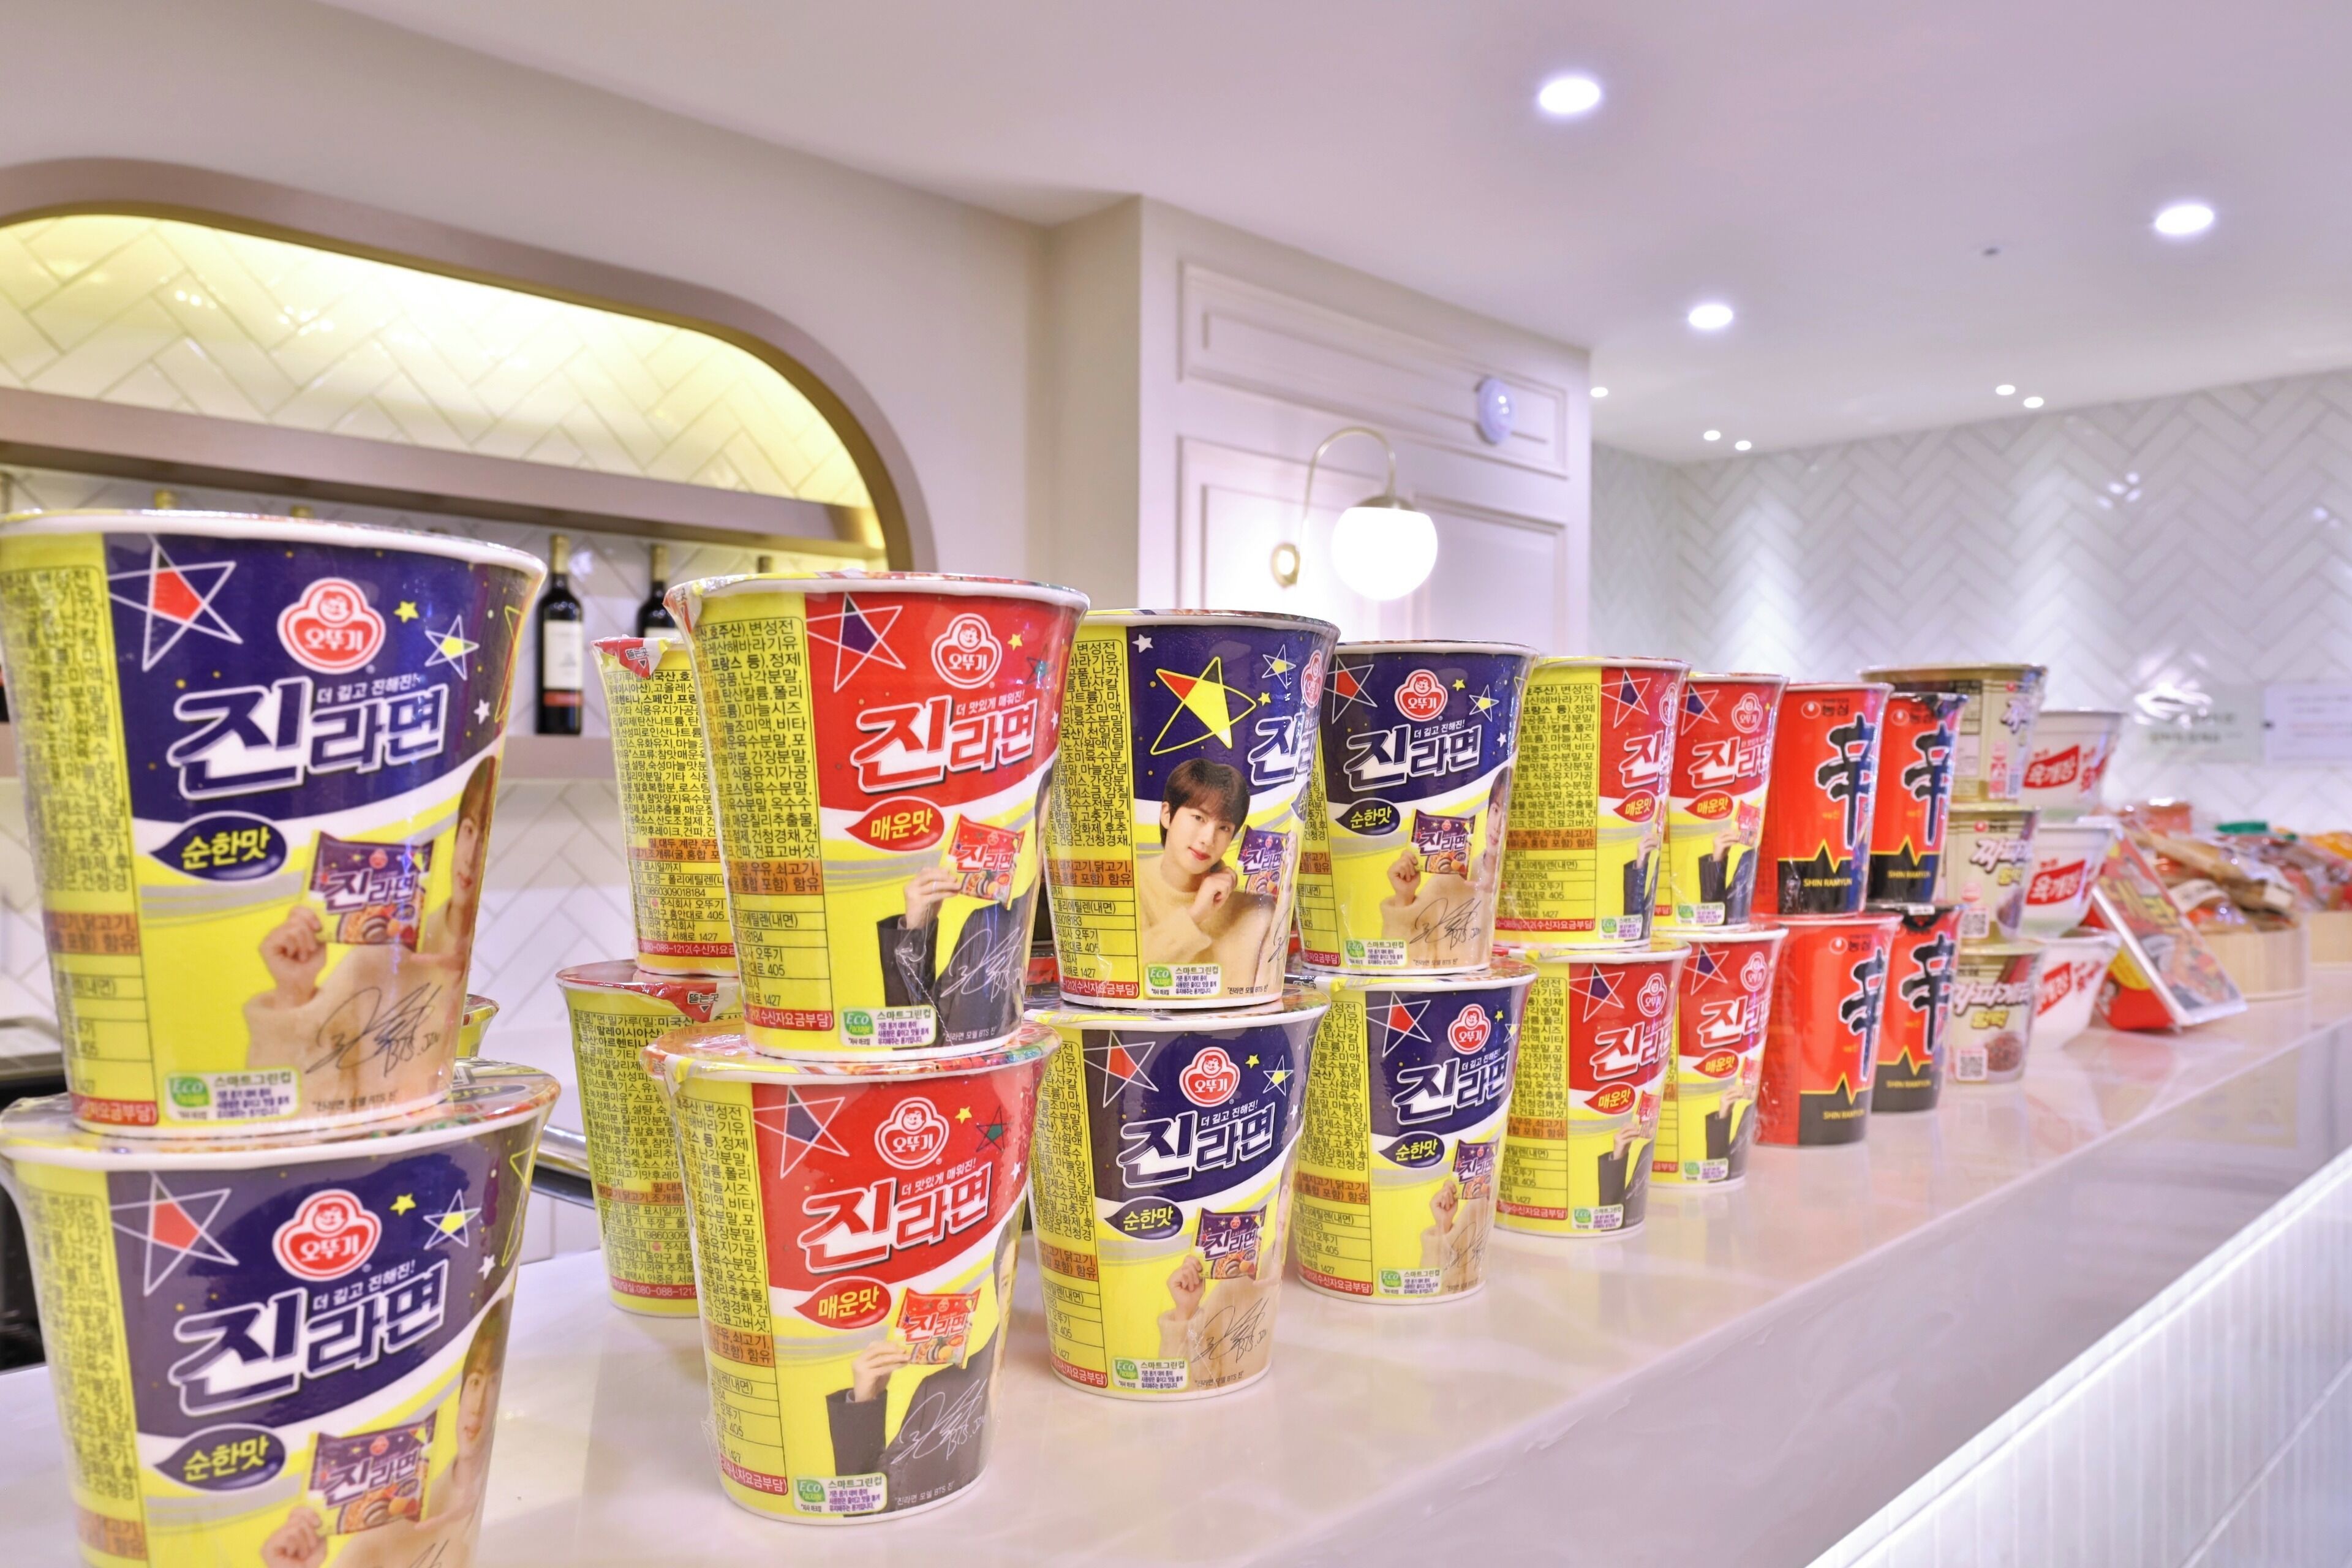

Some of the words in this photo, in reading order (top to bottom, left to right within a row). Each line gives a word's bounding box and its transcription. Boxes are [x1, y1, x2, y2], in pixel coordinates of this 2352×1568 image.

[305, 630, 363, 652] 오뚜기
[626, 648, 649, 660] 뜯는곳
[1077, 642, 1115, 656] 변성전
[948, 654, 987, 671] 오뚜기
[318, 687, 333, 703] 더
[371, 674, 420, 696] 진해진!
[956, 705, 965, 715] 더
[969, 699, 996, 714] 맛있게
[998, 692, 1025, 707] 매워진!
[1063, 703, 1125, 715] 마늘조미액,
[1408, 697, 1438, 710] 오뚜기
[1414, 729, 1422, 739] 더
[1424, 727, 1439, 736] 깊고
[1441, 719, 1466, 734] 진해진!
[167, 677, 449, 800] 진라면
[850, 695, 1038, 793] 진라면
[1343, 724, 1482, 792] 진라면
[733, 766, 808, 780] 식용유지가공
[1814, 712, 1879, 850] 辛
[1902, 721, 1955, 846] 辛
[1624, 797, 1653, 816] 매운맛
[1696, 796, 1729, 817] 매운맛
[871, 805, 933, 841] 매운맛
[1350, 807, 1392, 829] 순한맛
[181, 829, 271, 870] 순한맛
[1419, 831, 1466, 857] 진라면
[1577, 839, 1595, 848] 함유
[956, 844, 1014, 873] 진라면
[1243, 847, 1283, 876] 진라면
[644, 862, 682, 873] 표시일까지
[763, 878, 788, 892] 포함)
[794, 877, 820, 891] 함유
[1081, 873, 1104, 886] 포함)
[1108, 873, 1132, 886] 함유
[1539, 881, 1563, 891] 오뚜기
[1803, 878, 1823, 887] SHIN
[1824, 878, 1853, 887] RAMYUN
[325, 868, 418, 914] 진라면
[645, 887, 706, 897] 19860309018184
[660, 899, 692, 908] 주식회사
[696, 899, 724, 909] 오뚜기
[1057, 900, 1116, 914] 폴리에틸렌(내면)
[664, 921, 695, 931] 주식회사
[672, 931, 696, 941] 서해로
[699, 933, 718, 941] 1427
[756, 948, 783, 962] 오뚜기
[767, 964, 785, 976] 405
[1080, 968, 1096, 978] 1427
[1150, 968, 1169, 978] Eco
[1175, 966, 1219, 975] 스마트그린컵
[689, 992, 719, 1003] 뜯는곳
[764, 993, 781, 1006] 1427
[1901, 932, 1958, 1054] 辛
[846, 1014, 869, 1025] Eco
[876, 1008, 931, 1020] 스마트그린컵
[1840, 948, 1887, 1082] 辛
[1458, 1030, 1482, 1043] 오뚜기
[1462, 1062, 1468, 1071] 더
[1705, 1055, 1735, 1074] 매운맛
[1194, 1078, 1228, 1093] 오뚜기
[1392, 1051, 1510, 1125] 진라면
[1598, 1087, 1632, 1109] 매운맛
[1200, 1117, 1210, 1126] 더
[1213, 1112, 1229, 1123] 깊고
[1232, 1099, 1259, 1118] 진해진!
[1823, 1109, 1841, 1121] SHIN
[892, 1134, 933, 1153] 오뚜기
[1116, 1102, 1275, 1189] 진라면
[1395, 1139, 1438, 1162] 순한맛
[902, 1185, 911, 1195] 더
[915, 1175, 944, 1194] 맛있게
[947, 1158, 976, 1181] 매워진!
[1512, 1168, 1536, 1178] 오뚜기
[1521, 1178, 1536, 1187] 405
[1348, 1193, 1369, 1203] 함유
[797, 1162, 992, 1273] 진라면
[1123, 1205, 1174, 1232] 순한맛
[1203, 1227, 1258, 1261] 진라면
[1316, 1231, 1338, 1246] 오뚜기
[300, 1235, 360, 1259] 오뚜기
[1325, 1246, 1339, 1256] 405
[1077, 1266, 1097, 1279] 함유
[314, 1297, 328, 1310] 더
[369, 1259, 415, 1296] 진해진!
[818, 1286, 880, 1319] 매운맛
[903, 1311, 968, 1343] 진라면
[1060, 1328, 1072, 1339] 405
[168, 1259, 449, 1416] 진라면
[748, 1349, 771, 1364] 함유
[1116, 1361, 1136, 1371] Eco
[1140, 1361, 1185, 1370] 스마트그린컵
[729, 1424, 744, 1438] 405
[184, 1438, 270, 1481] 순한맛
[325, 1457, 420, 1507] 진라면
[799, 1481, 821, 1493] Eco
[828, 1476, 882, 1488] 스마트그린컵
